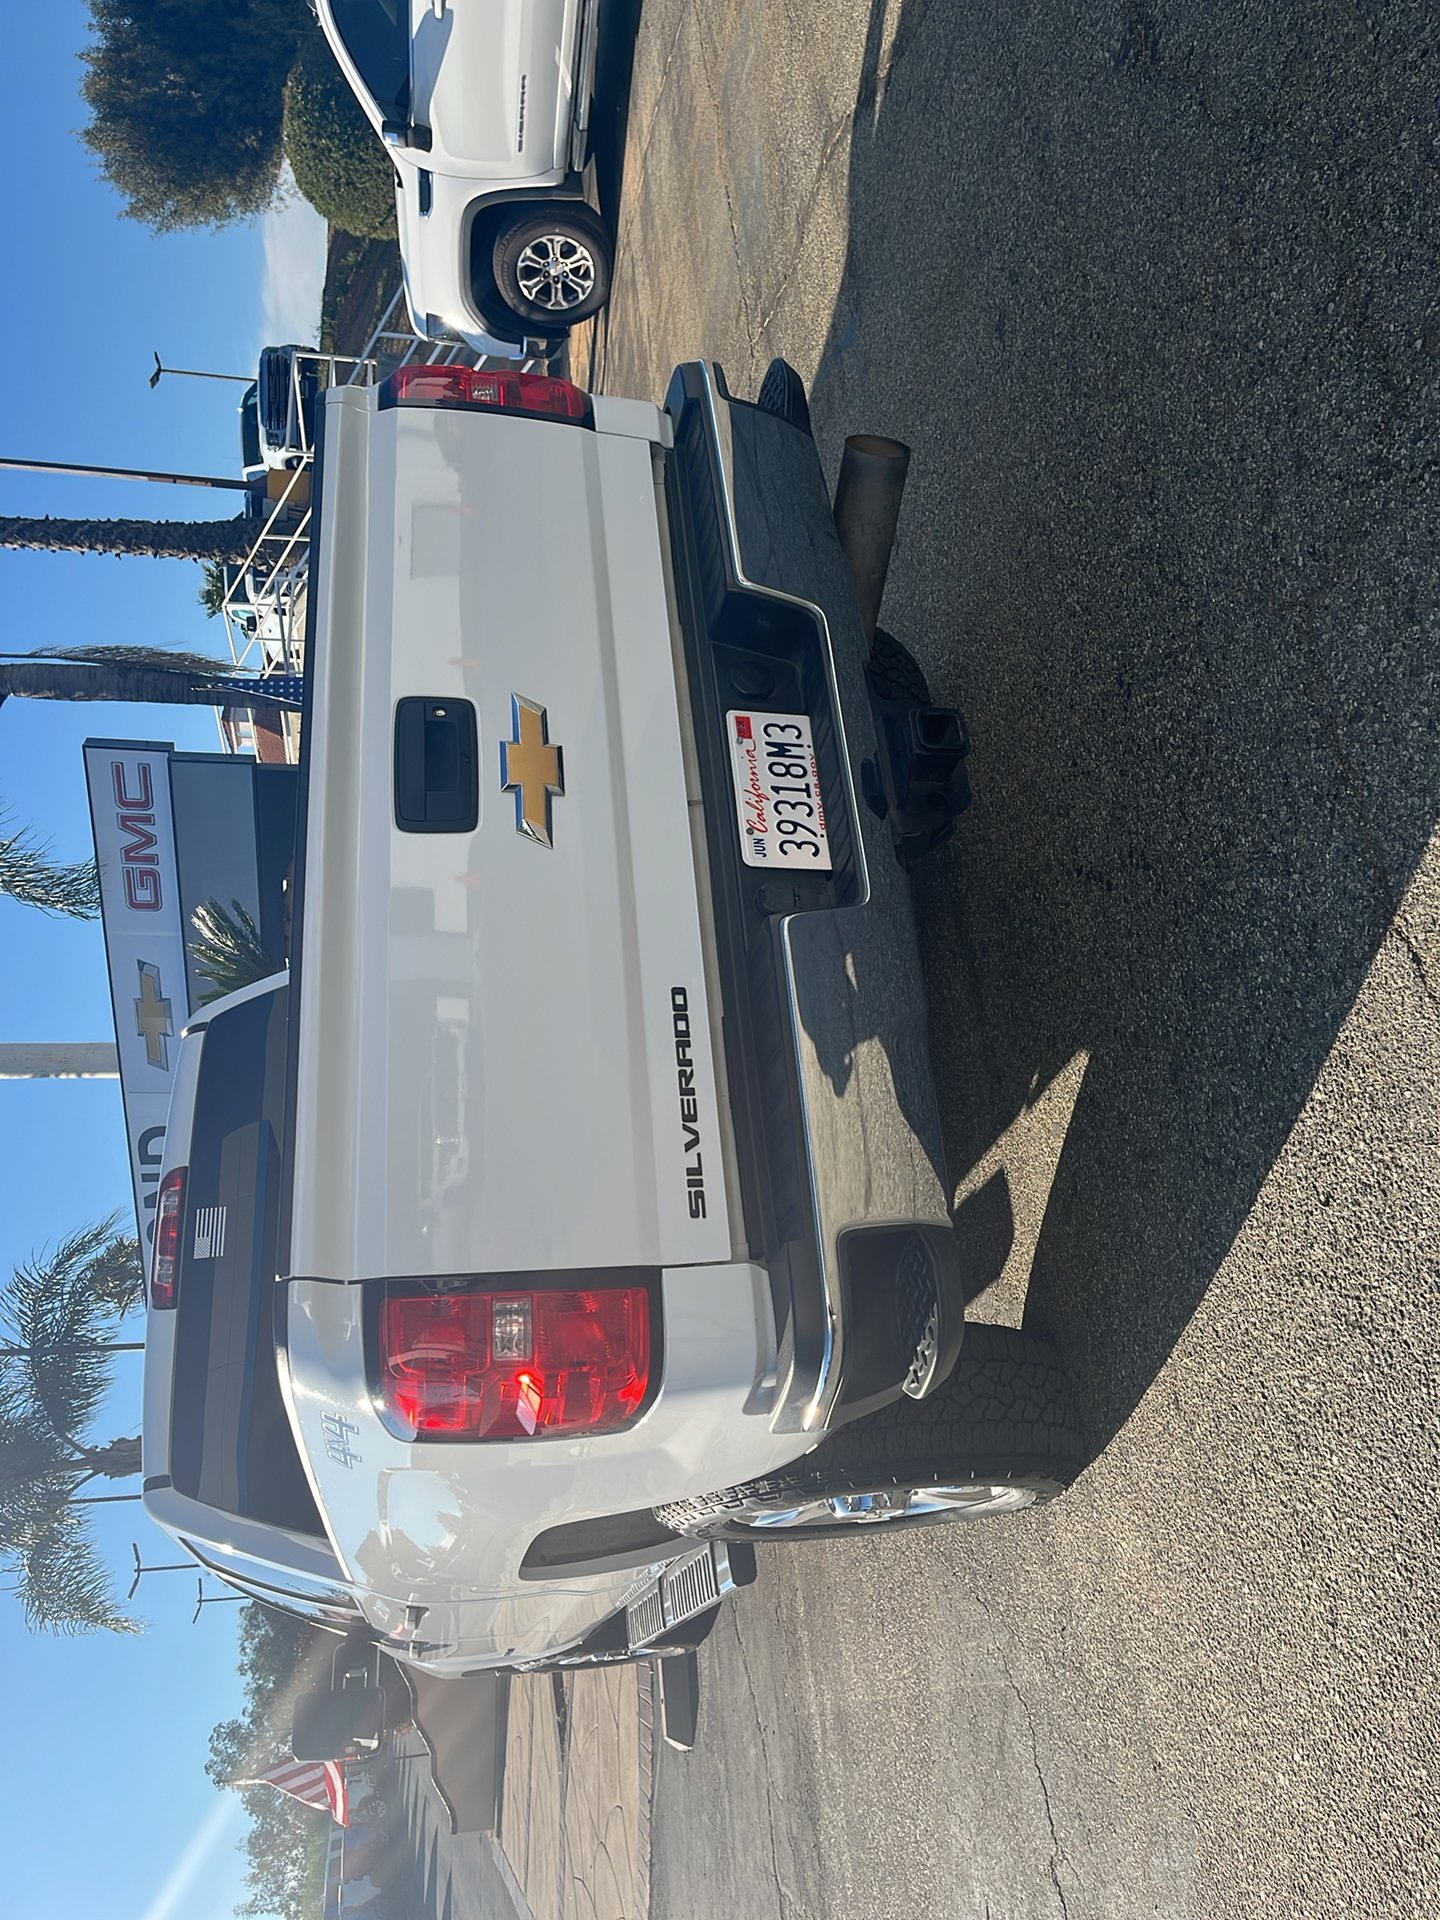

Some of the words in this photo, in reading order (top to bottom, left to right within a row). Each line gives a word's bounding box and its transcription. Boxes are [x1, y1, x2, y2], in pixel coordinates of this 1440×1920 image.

[517, 74, 527, 153] SIERRA
[743, 739, 770, 833] California
[762, 722, 820, 858] 39318M3
[808, 752, 826, 831] dmv.ca.gov
[111, 761, 163, 912] GMC
[752, 838, 767, 858] JUN
[670, 986, 707, 1220] SILVERADO
